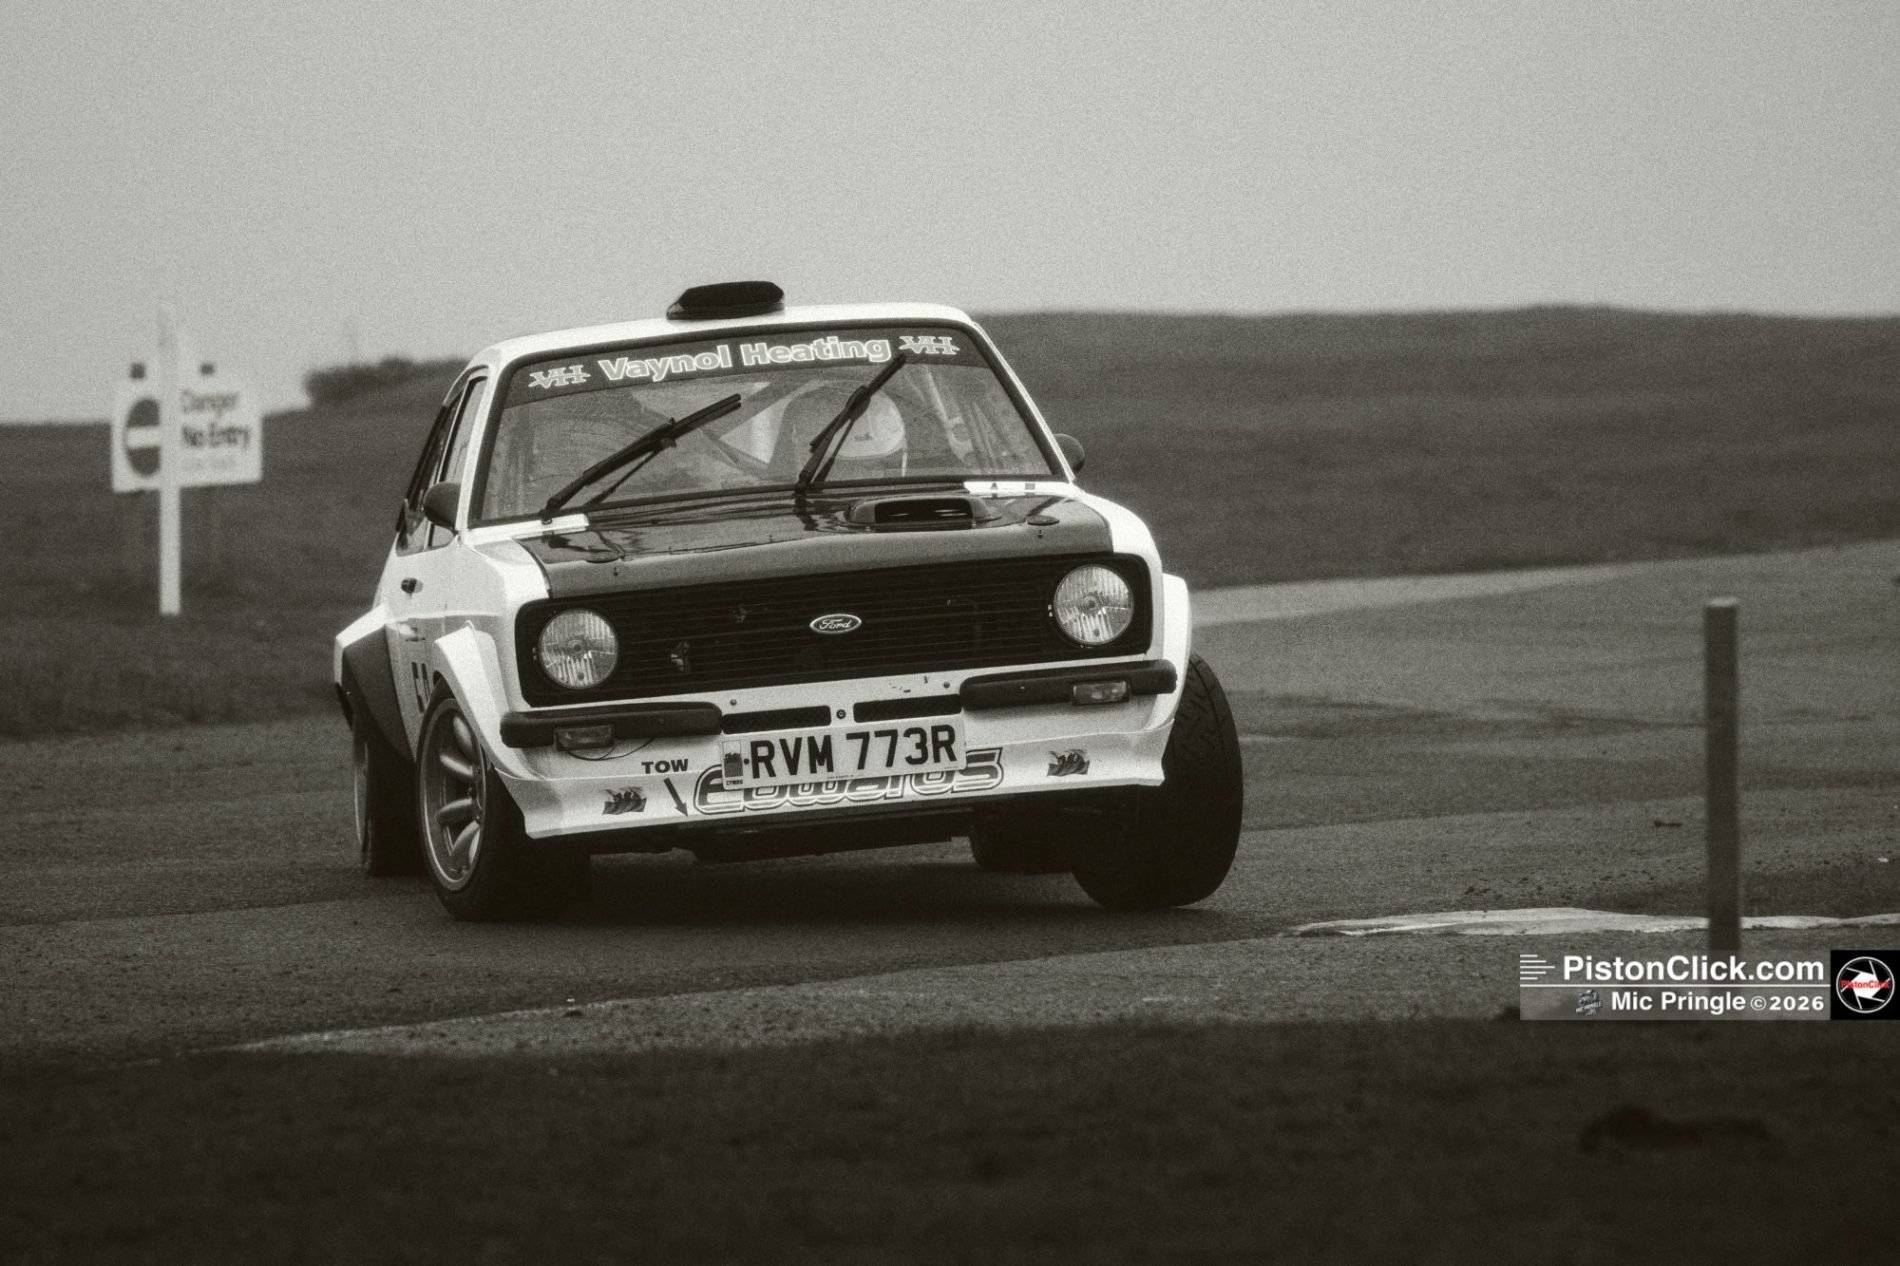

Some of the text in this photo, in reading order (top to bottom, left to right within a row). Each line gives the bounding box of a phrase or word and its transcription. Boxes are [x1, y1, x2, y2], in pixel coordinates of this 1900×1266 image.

[597, 344, 733, 382] Vaynol
[740, 336, 892, 363] Heating
[820, 618, 852, 630] Ford
[641, 758, 689, 774] TOW
[751, 724, 957, 779] RVM 773R
